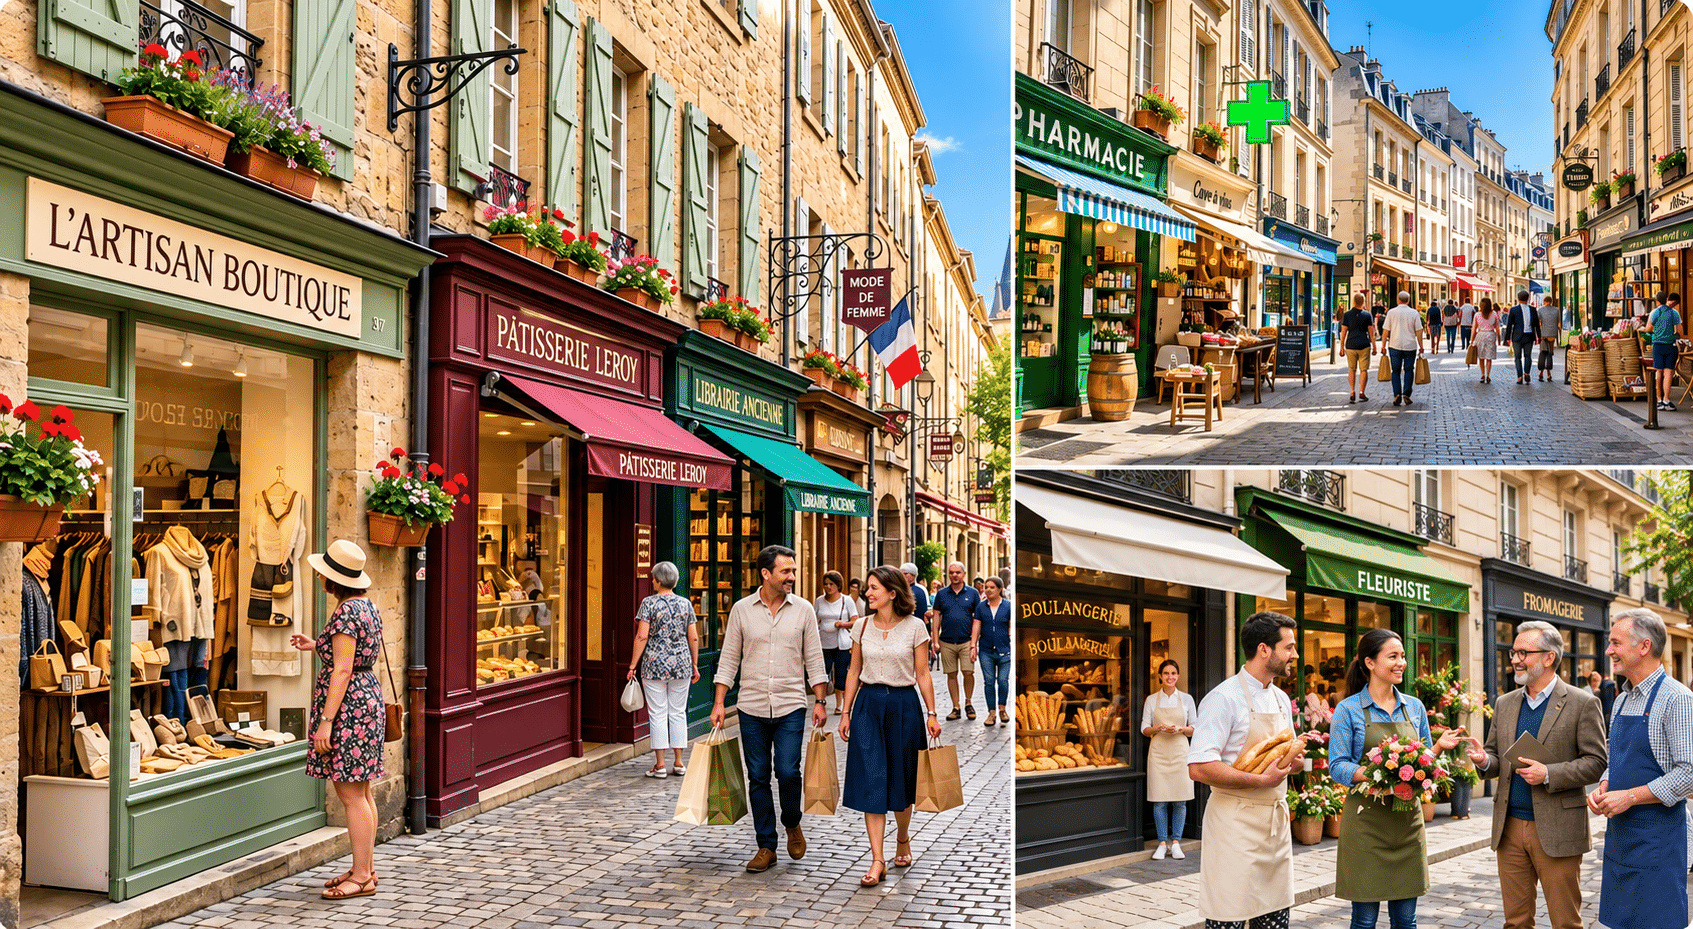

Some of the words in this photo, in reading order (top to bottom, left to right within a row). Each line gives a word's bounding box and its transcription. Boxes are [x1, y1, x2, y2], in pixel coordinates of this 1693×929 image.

[1193, 180, 1213, 202] Cave
[49, 202, 214, 287] L'ARTISAN
[223, 252, 351, 322] BOUTIQUE
[850, 276, 884, 288] MODE
[859, 291, 874, 303] DE
[846, 306, 886, 318] FEMME
[595, 346, 638, 384] LEROY
[695, 378, 740, 414] LIBRAIRIE
[741, 394, 784, 425] ANCIENNE
[680, 462, 708, 484] LEROY
[1357, 570, 1431, 602] FLEURISTE
[1020, 600, 1122, 626] BOULANGERIE
[1523, 591, 1585, 621] FROMAGERIE
